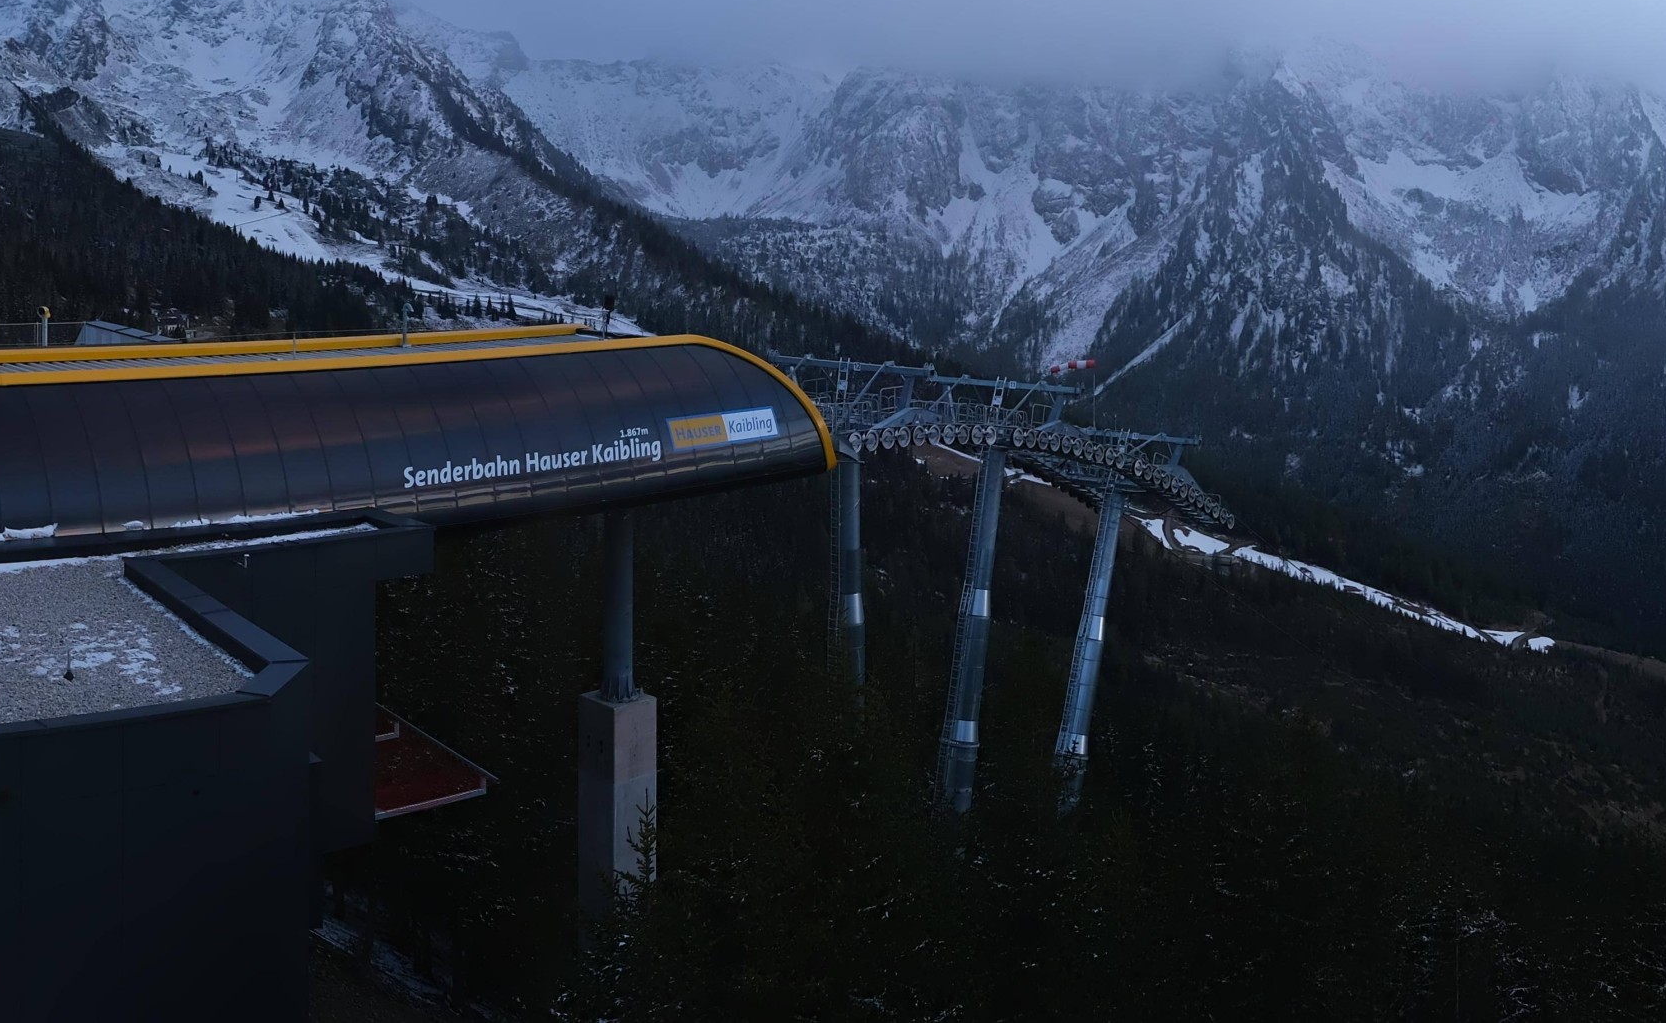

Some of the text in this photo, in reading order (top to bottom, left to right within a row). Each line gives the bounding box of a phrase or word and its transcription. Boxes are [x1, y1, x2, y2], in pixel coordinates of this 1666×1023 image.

[619, 427, 649, 438] 1.867m
[675, 417, 773, 441] HAUSER Kaibling
[403, 437, 662, 489] Senderbahn Hauser Kaibling
